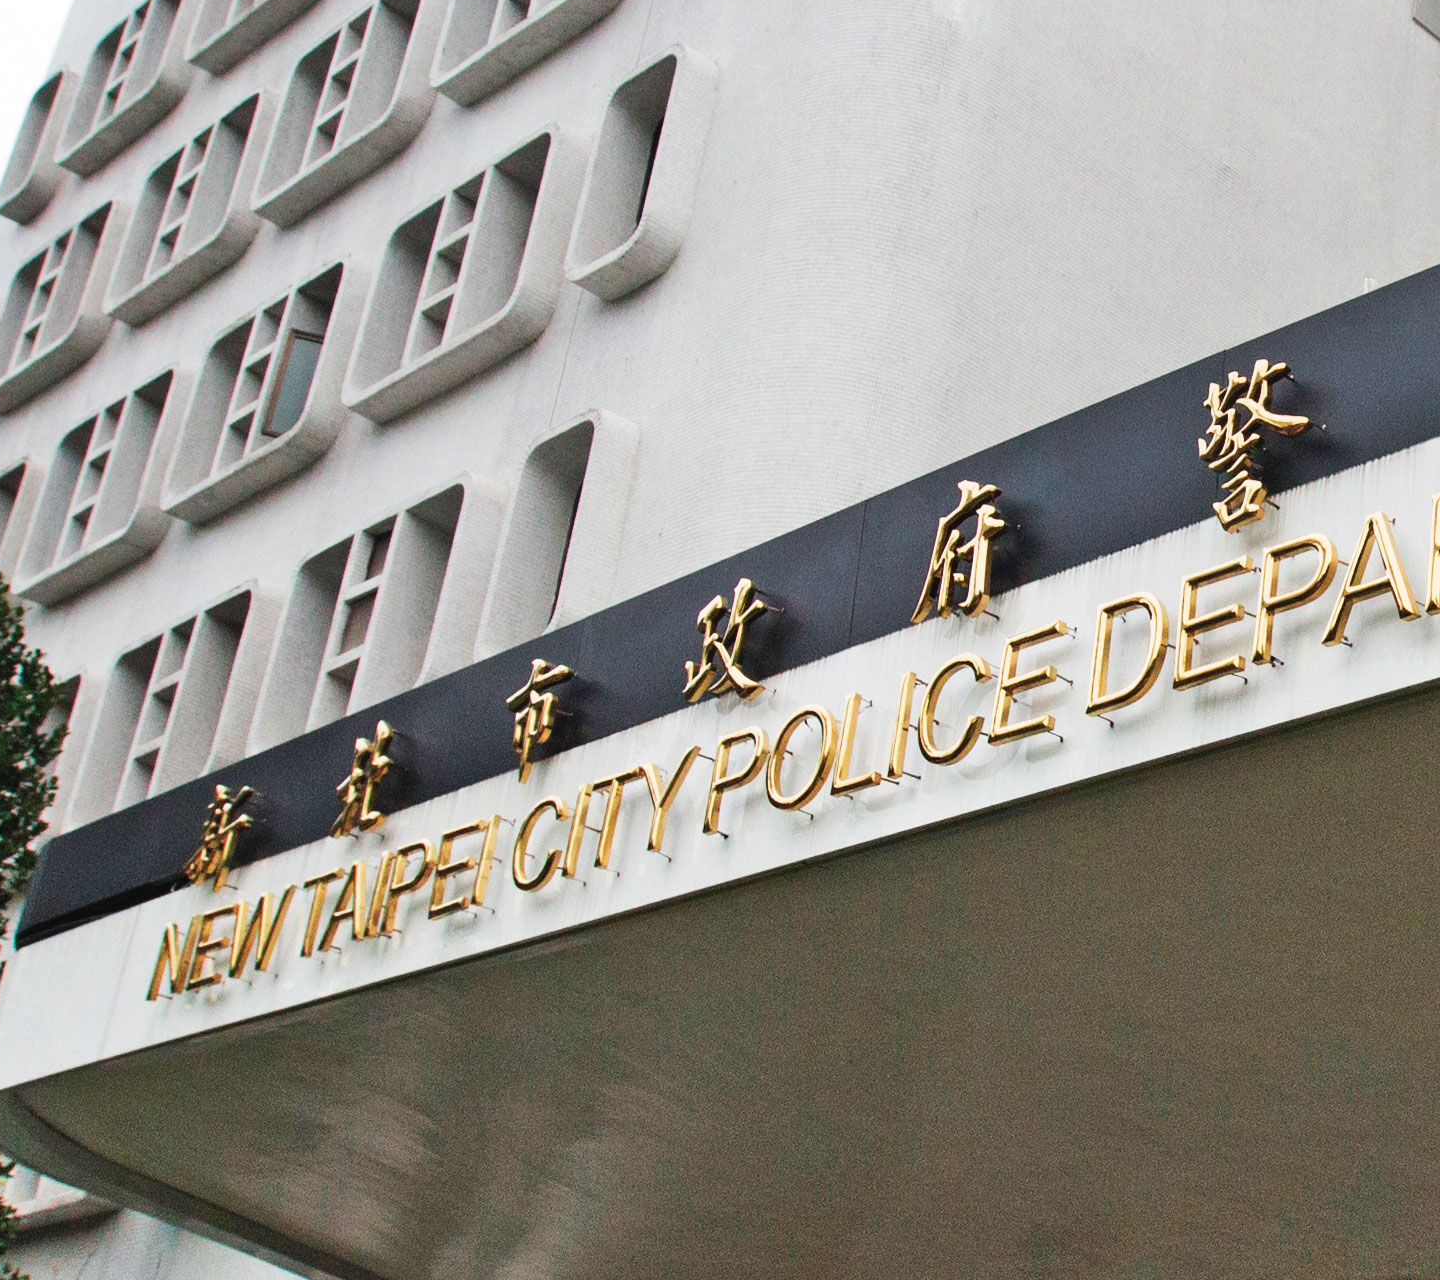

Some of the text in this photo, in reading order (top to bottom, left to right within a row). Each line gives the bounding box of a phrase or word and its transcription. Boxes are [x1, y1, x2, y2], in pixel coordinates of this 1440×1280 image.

[147, 882, 297, 1002] NEW
[301, 813, 501, 958] TAIPEI
[513, 745, 702, 892] CITY
[703, 620, 1068, 835] POLICE
